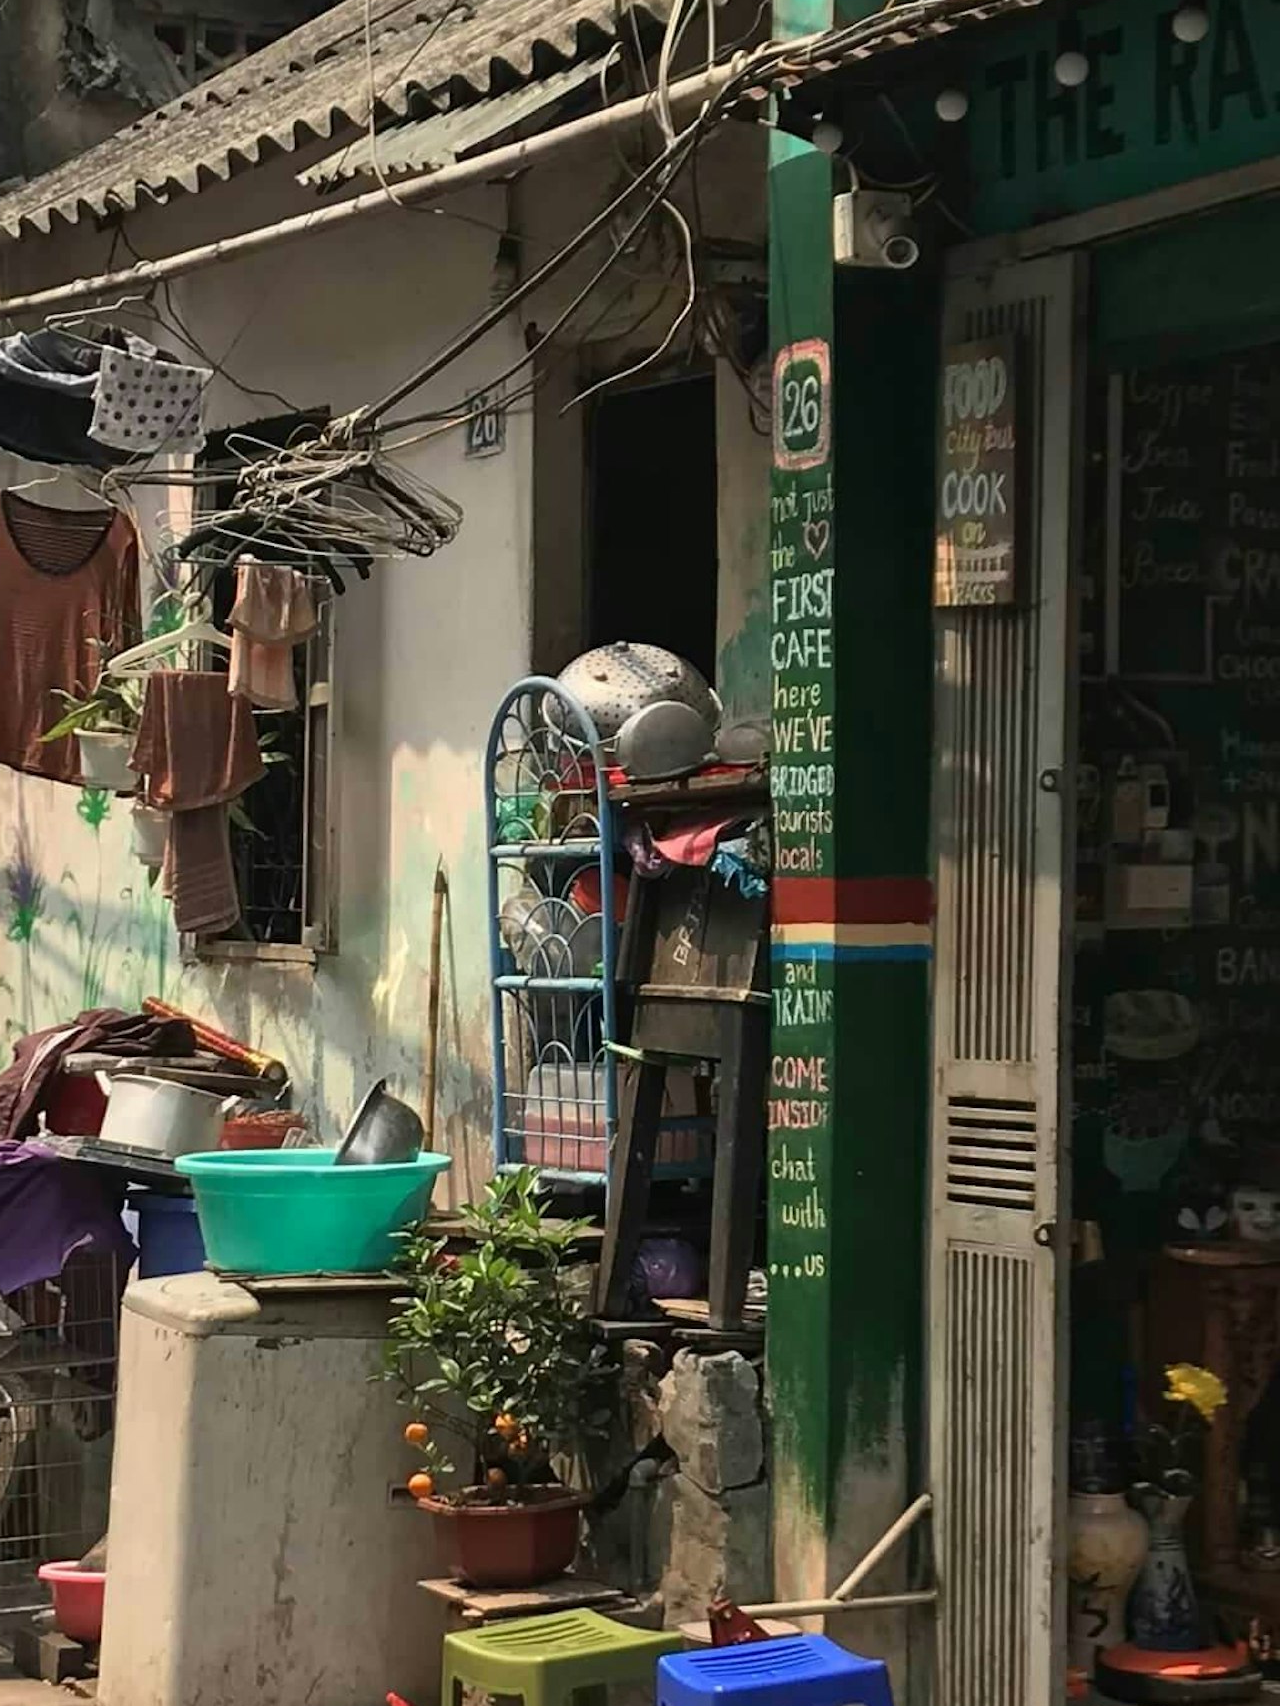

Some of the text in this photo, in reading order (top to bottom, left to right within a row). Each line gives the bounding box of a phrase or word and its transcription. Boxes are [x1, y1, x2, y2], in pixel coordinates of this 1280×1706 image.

[985, 23, 1127, 179] THE
[783, 374, 819, 438] 26
[943, 354, 1008, 426] FOOD
[945, 424, 984, 473] city
[771, 479, 798, 524] not
[941, 469, 1008, 519] COOK
[771, 530, 795, 572] the
[772, 567, 835, 624] FIRST
[770, 628, 833, 671] CAFE
[773, 673, 822, 710] here
[772, 708, 833, 754] WE'VE
[770, 763, 836, 797] BRIDGED
[772, 797, 834, 834] tourists
[773, 835, 824, 872] locals
[784, 948, 817, 986] and
[771, 1055, 830, 1094] COME
[770, 1143, 817, 1183] chat
[781, 1186, 827, 1230] with
